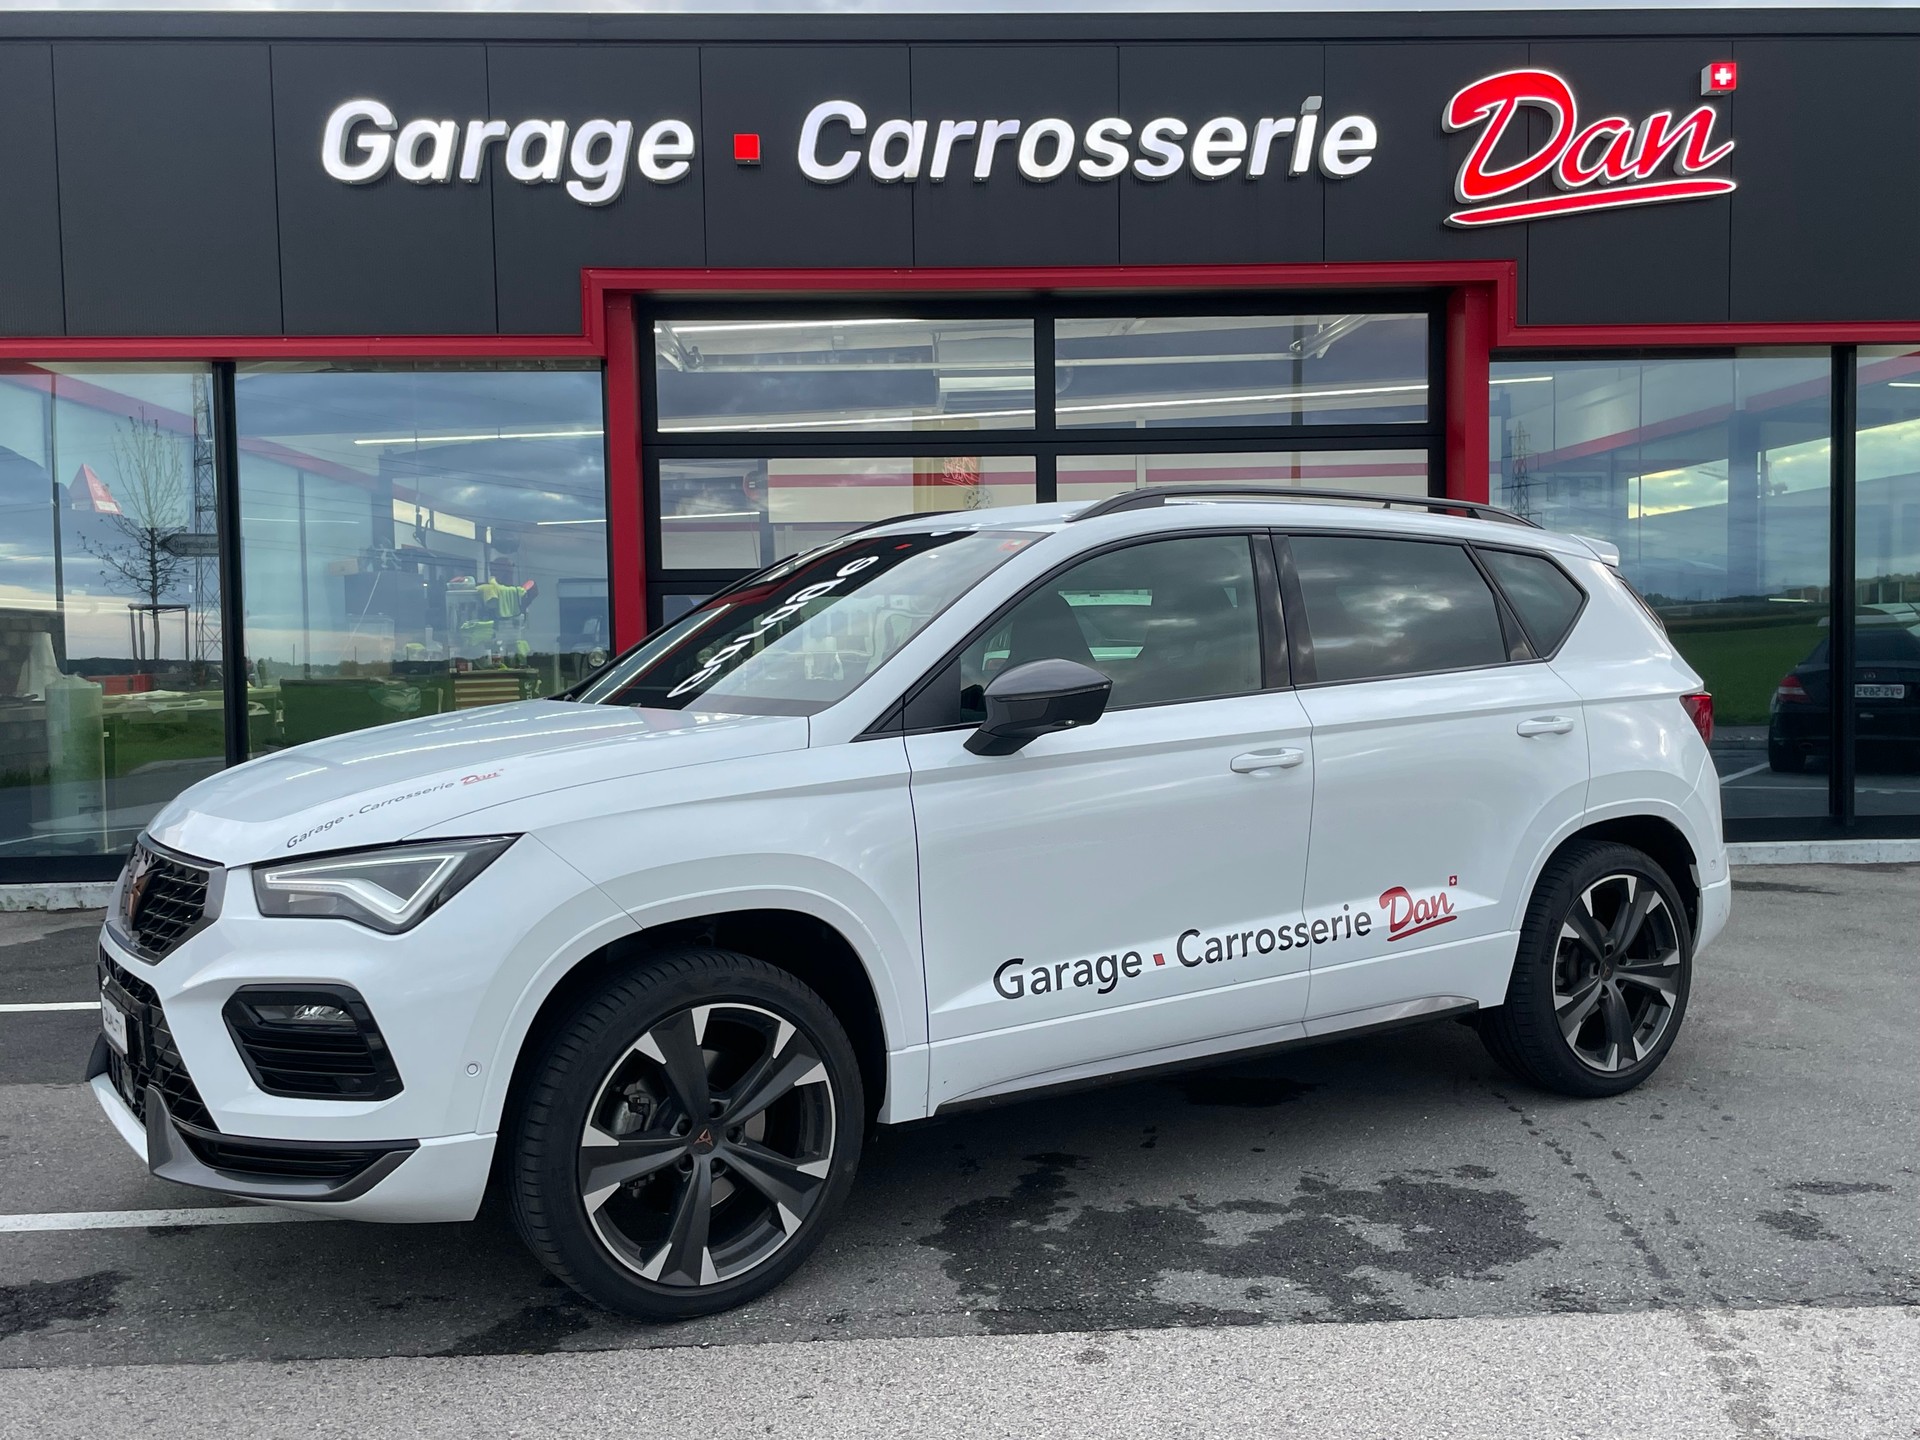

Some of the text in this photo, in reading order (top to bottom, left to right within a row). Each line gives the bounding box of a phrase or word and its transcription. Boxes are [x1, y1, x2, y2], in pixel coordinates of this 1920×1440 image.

[322, 68, 1736, 228] Garage Carrosserie Dan
[286, 770, 502, 849] Garage Carrosserie Dan
[992, 885, 1457, 1000] Garage Carrosserie Dan
